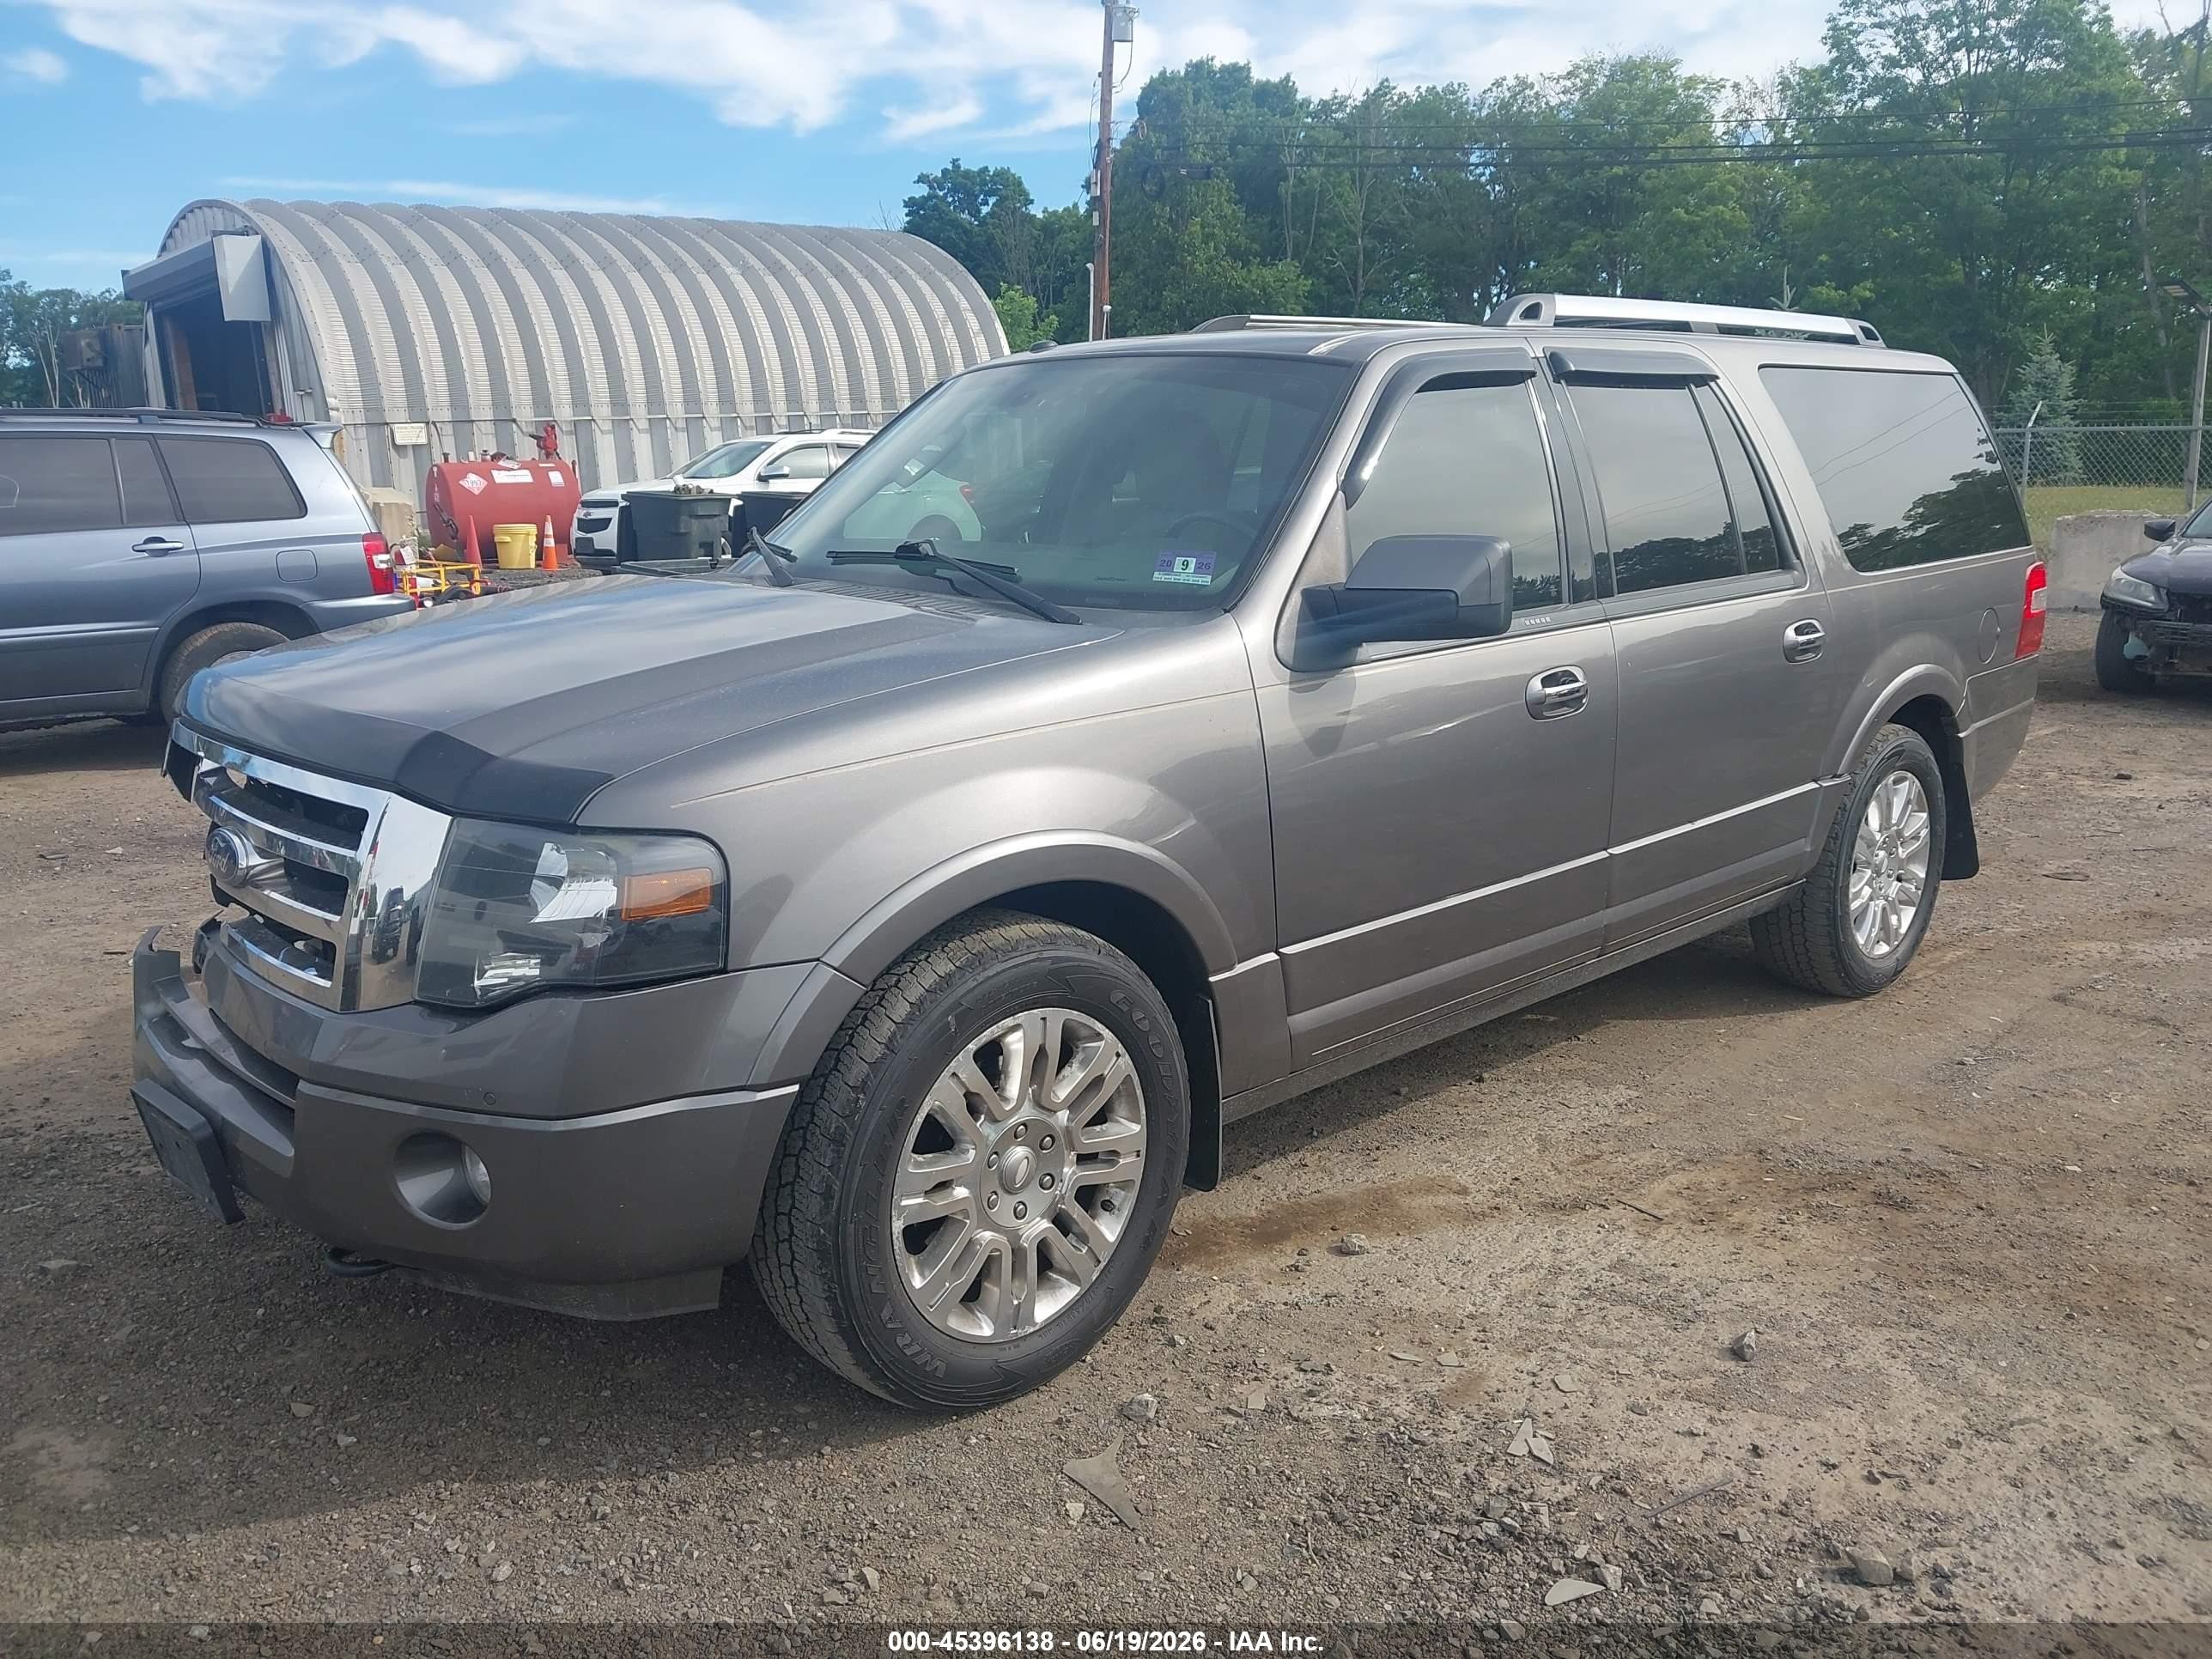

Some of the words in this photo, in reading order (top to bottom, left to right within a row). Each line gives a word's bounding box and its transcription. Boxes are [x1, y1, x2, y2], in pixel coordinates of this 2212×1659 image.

[1160, 559, 1172, 568] 20
[1181, 559, 1189, 571] 9
[1196, 562, 1211, 570] 26
[208, 836, 230, 873] Ford
